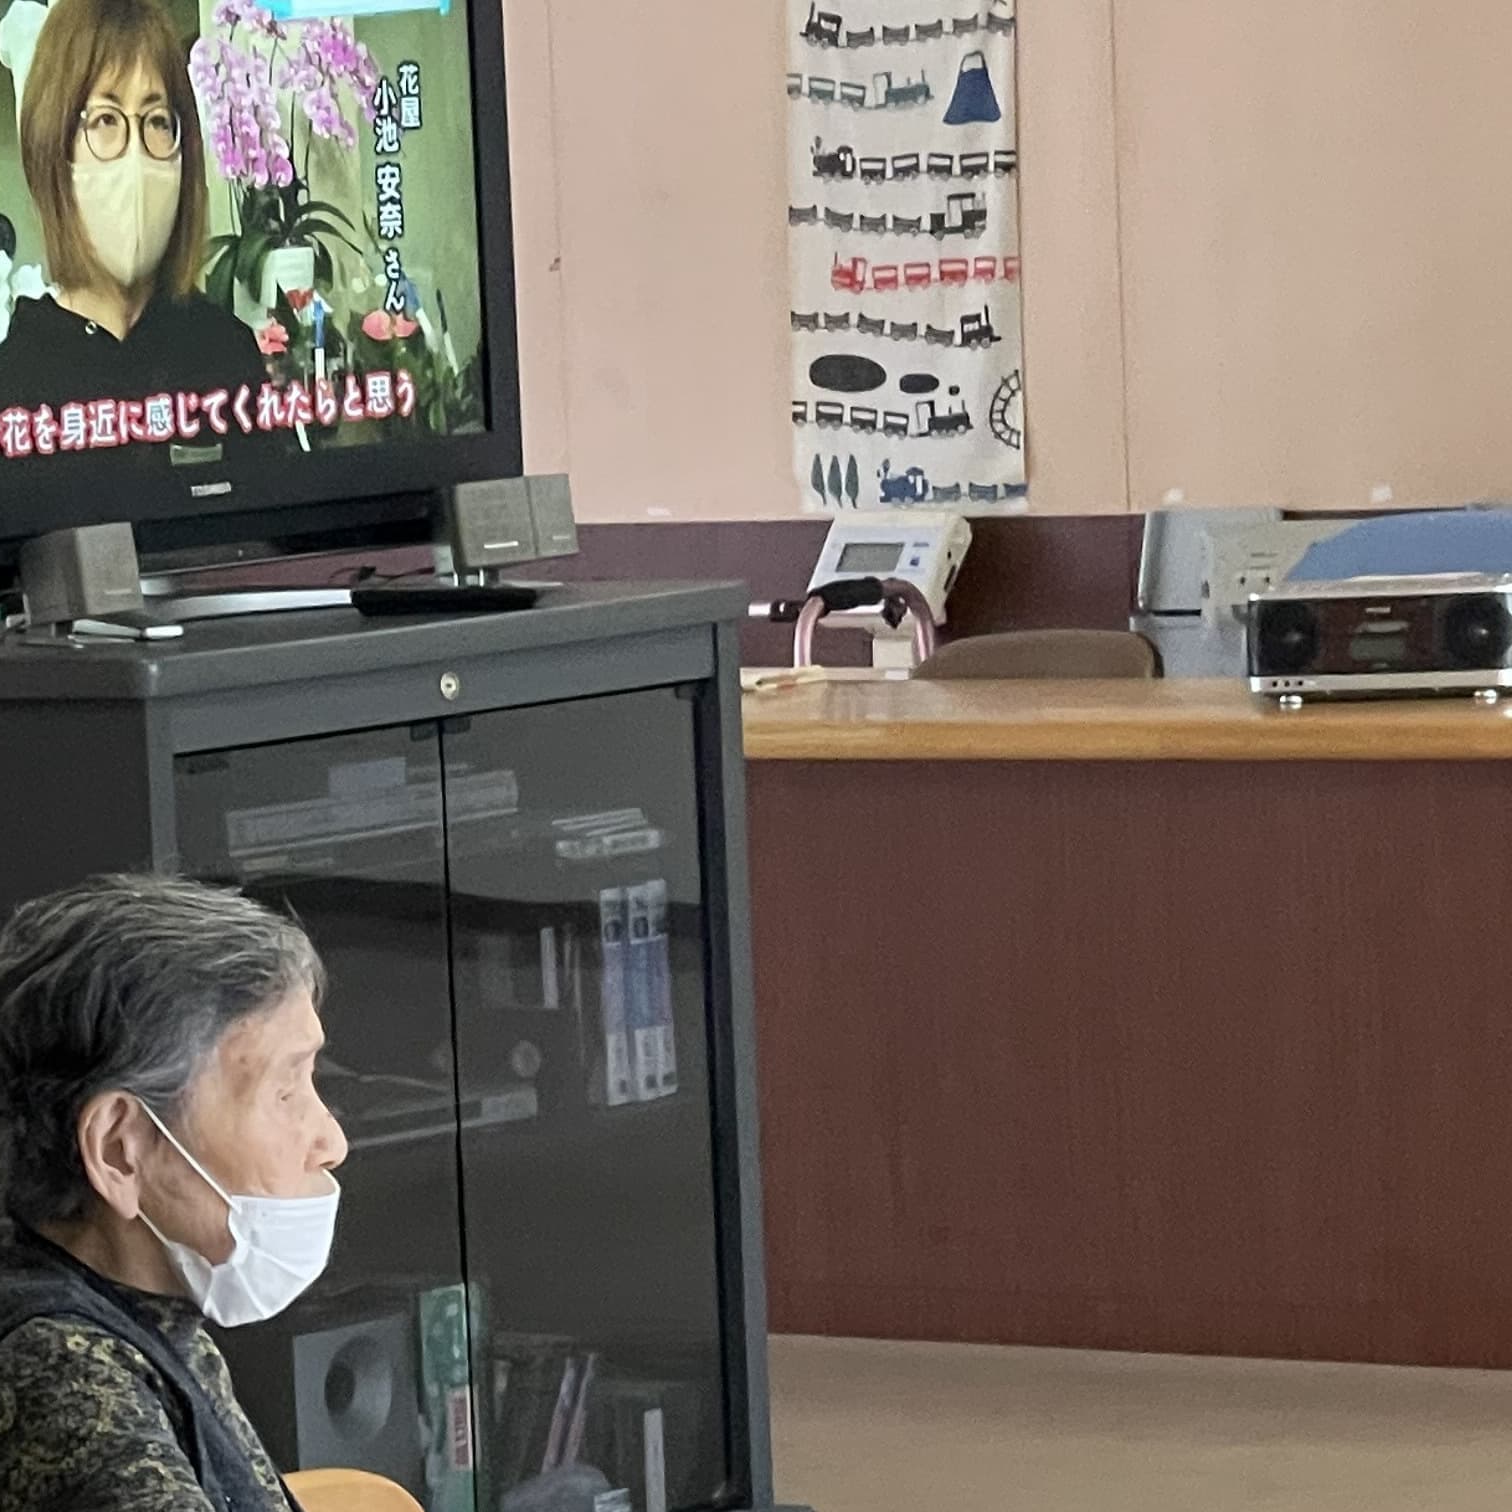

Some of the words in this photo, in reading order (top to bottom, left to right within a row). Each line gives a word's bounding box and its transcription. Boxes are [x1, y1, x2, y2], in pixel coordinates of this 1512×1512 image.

[374, 79, 399, 152] 小池
[399, 63, 420, 128] 花屋
[377, 164, 402, 238] 安奈
[385, 249, 405, 313] さん
